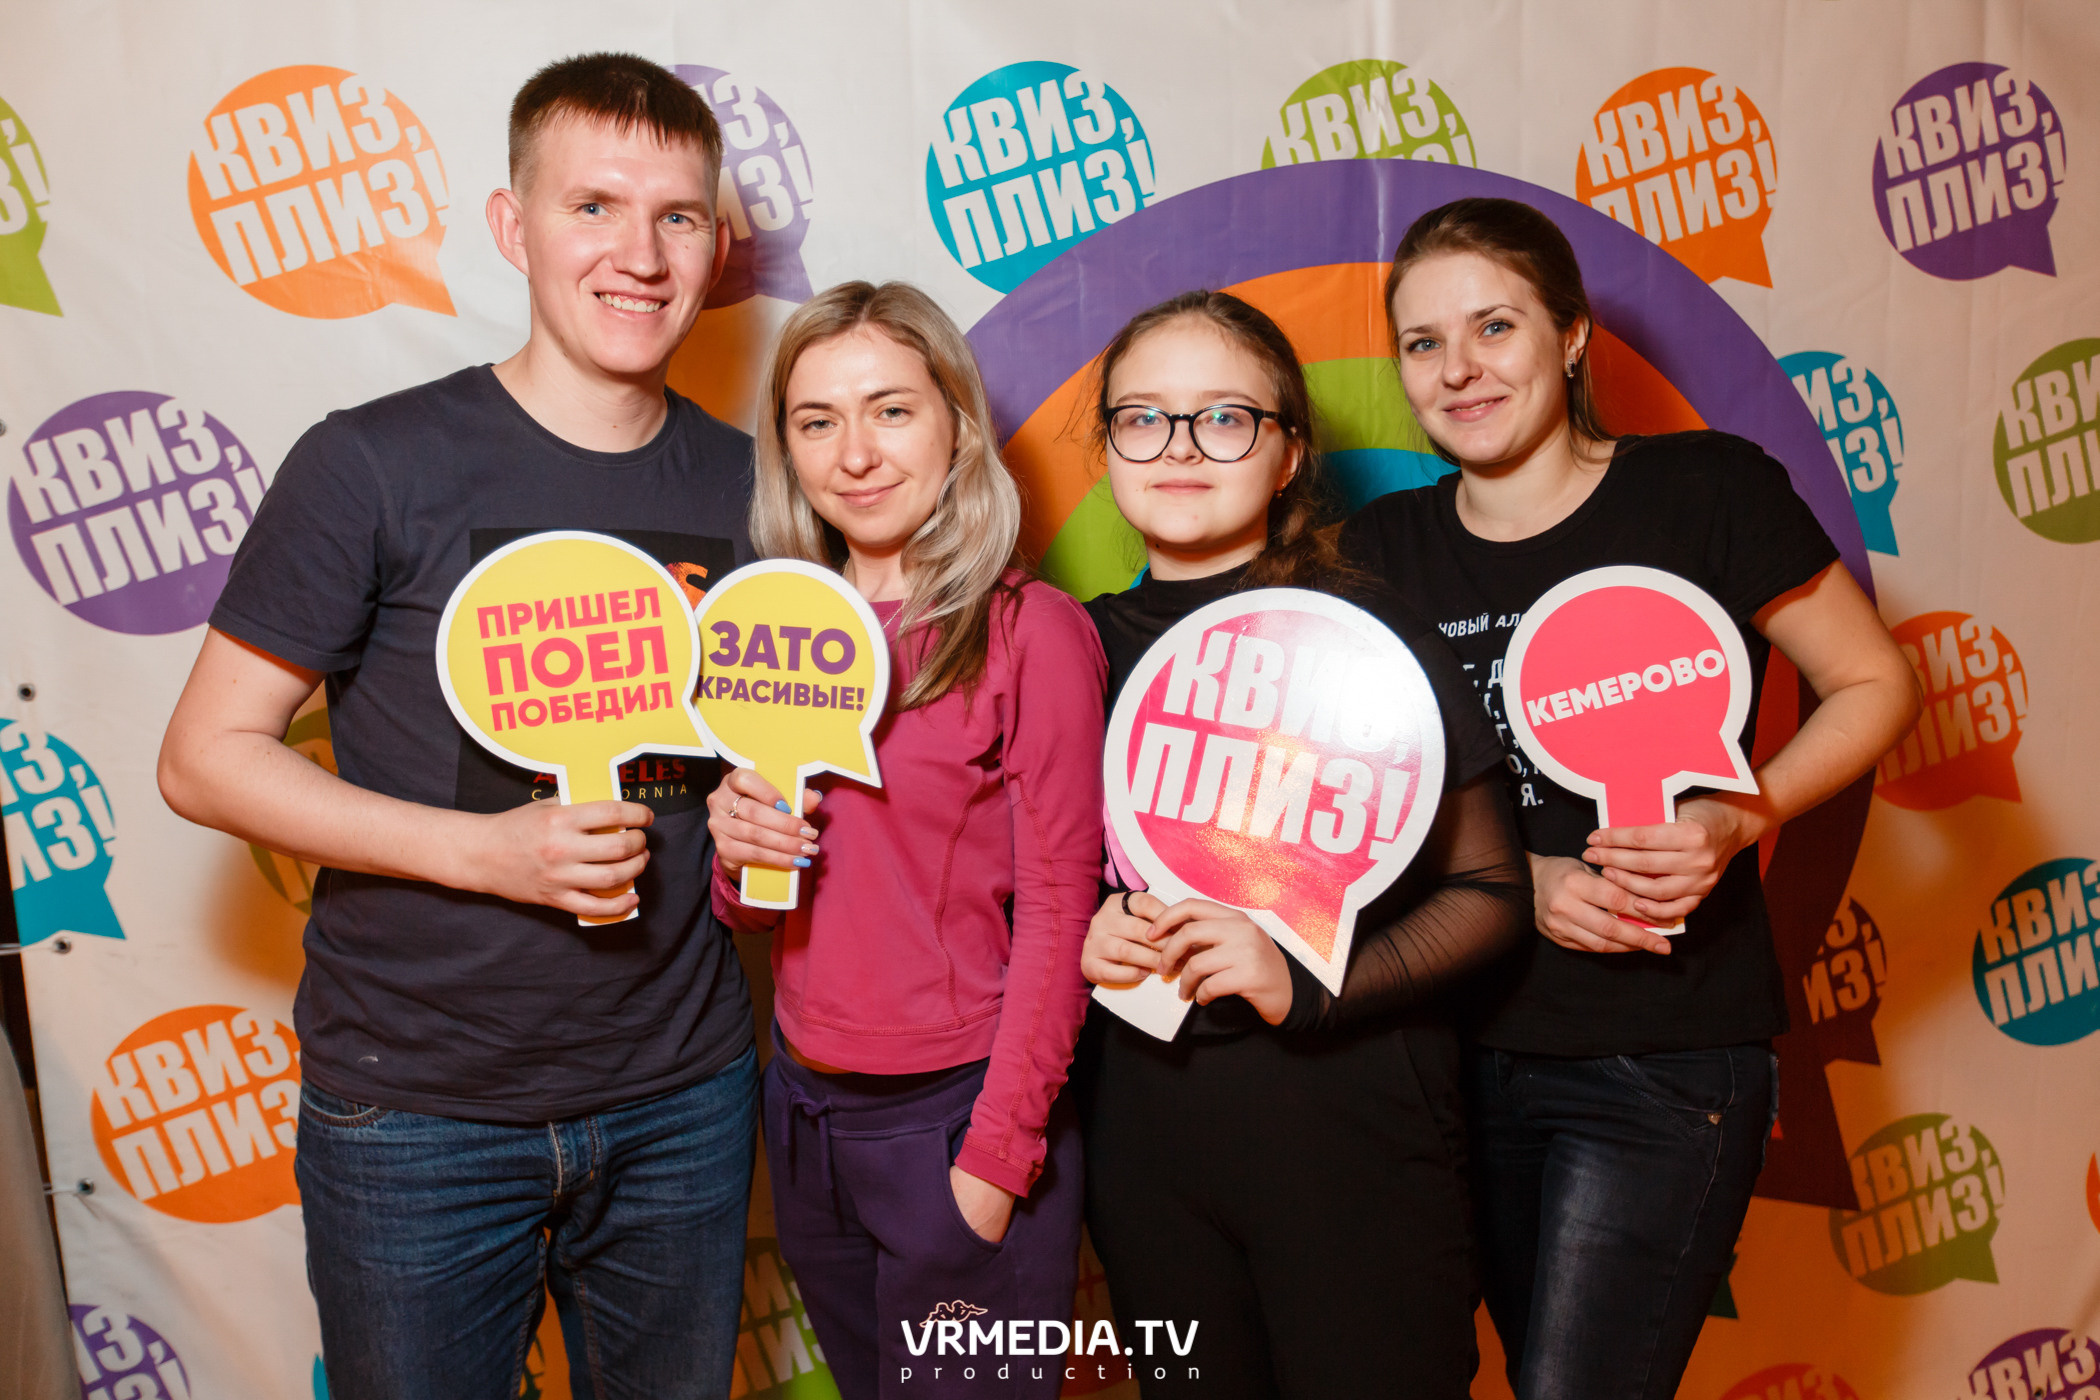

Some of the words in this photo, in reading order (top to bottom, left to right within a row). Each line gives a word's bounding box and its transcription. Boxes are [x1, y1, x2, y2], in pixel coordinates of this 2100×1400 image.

[194, 74, 420, 200] КВИЗ,
[931, 70, 1134, 189] КВИЗ,
[1267, 67, 1457, 166] КВИЗ,
[1582, 74, 1761, 188] КВИЗ,
[1880, 69, 2053, 180] КВИЗ,
[209, 150, 450, 286] ПЛИЗ!
[942, 139, 1155, 269] ПЛИЗ!
[1886, 131, 2066, 253] ПЛИЗ!
[1792, 357, 1889, 432] ИЗ,
[2001, 352, 2100, 450] КВИ
[11, 398, 243, 525] КВИЗ,
[477, 587, 662, 639] ПРИШЕЛ
[483, 625, 669, 696] ПОЕЛ
[708, 620, 856, 675] ЗАТО
[1900, 617, 2014, 694] ВИЗ,
[491, 681, 674, 732] ПОБЕДИЛ
[697, 675, 865, 712] КРАСИВЫЕ!
[1526, 648, 1726, 727] КЕМЕРОВО
[1, 784, 116, 891] ИЗ!
[1135, 721, 1412, 864] ПЛИЗ!
[1979, 860, 2100, 965] КВИ
[1802, 938, 1888, 1026] ИЗ!
[1984, 928, 2100, 1028] ПЛИ
[94, 1009, 301, 1131] КВИЗ
[111, 1078, 301, 1201] ПЛИЗ
[1842, 1165, 2005, 1278] ПЛИЗ!
